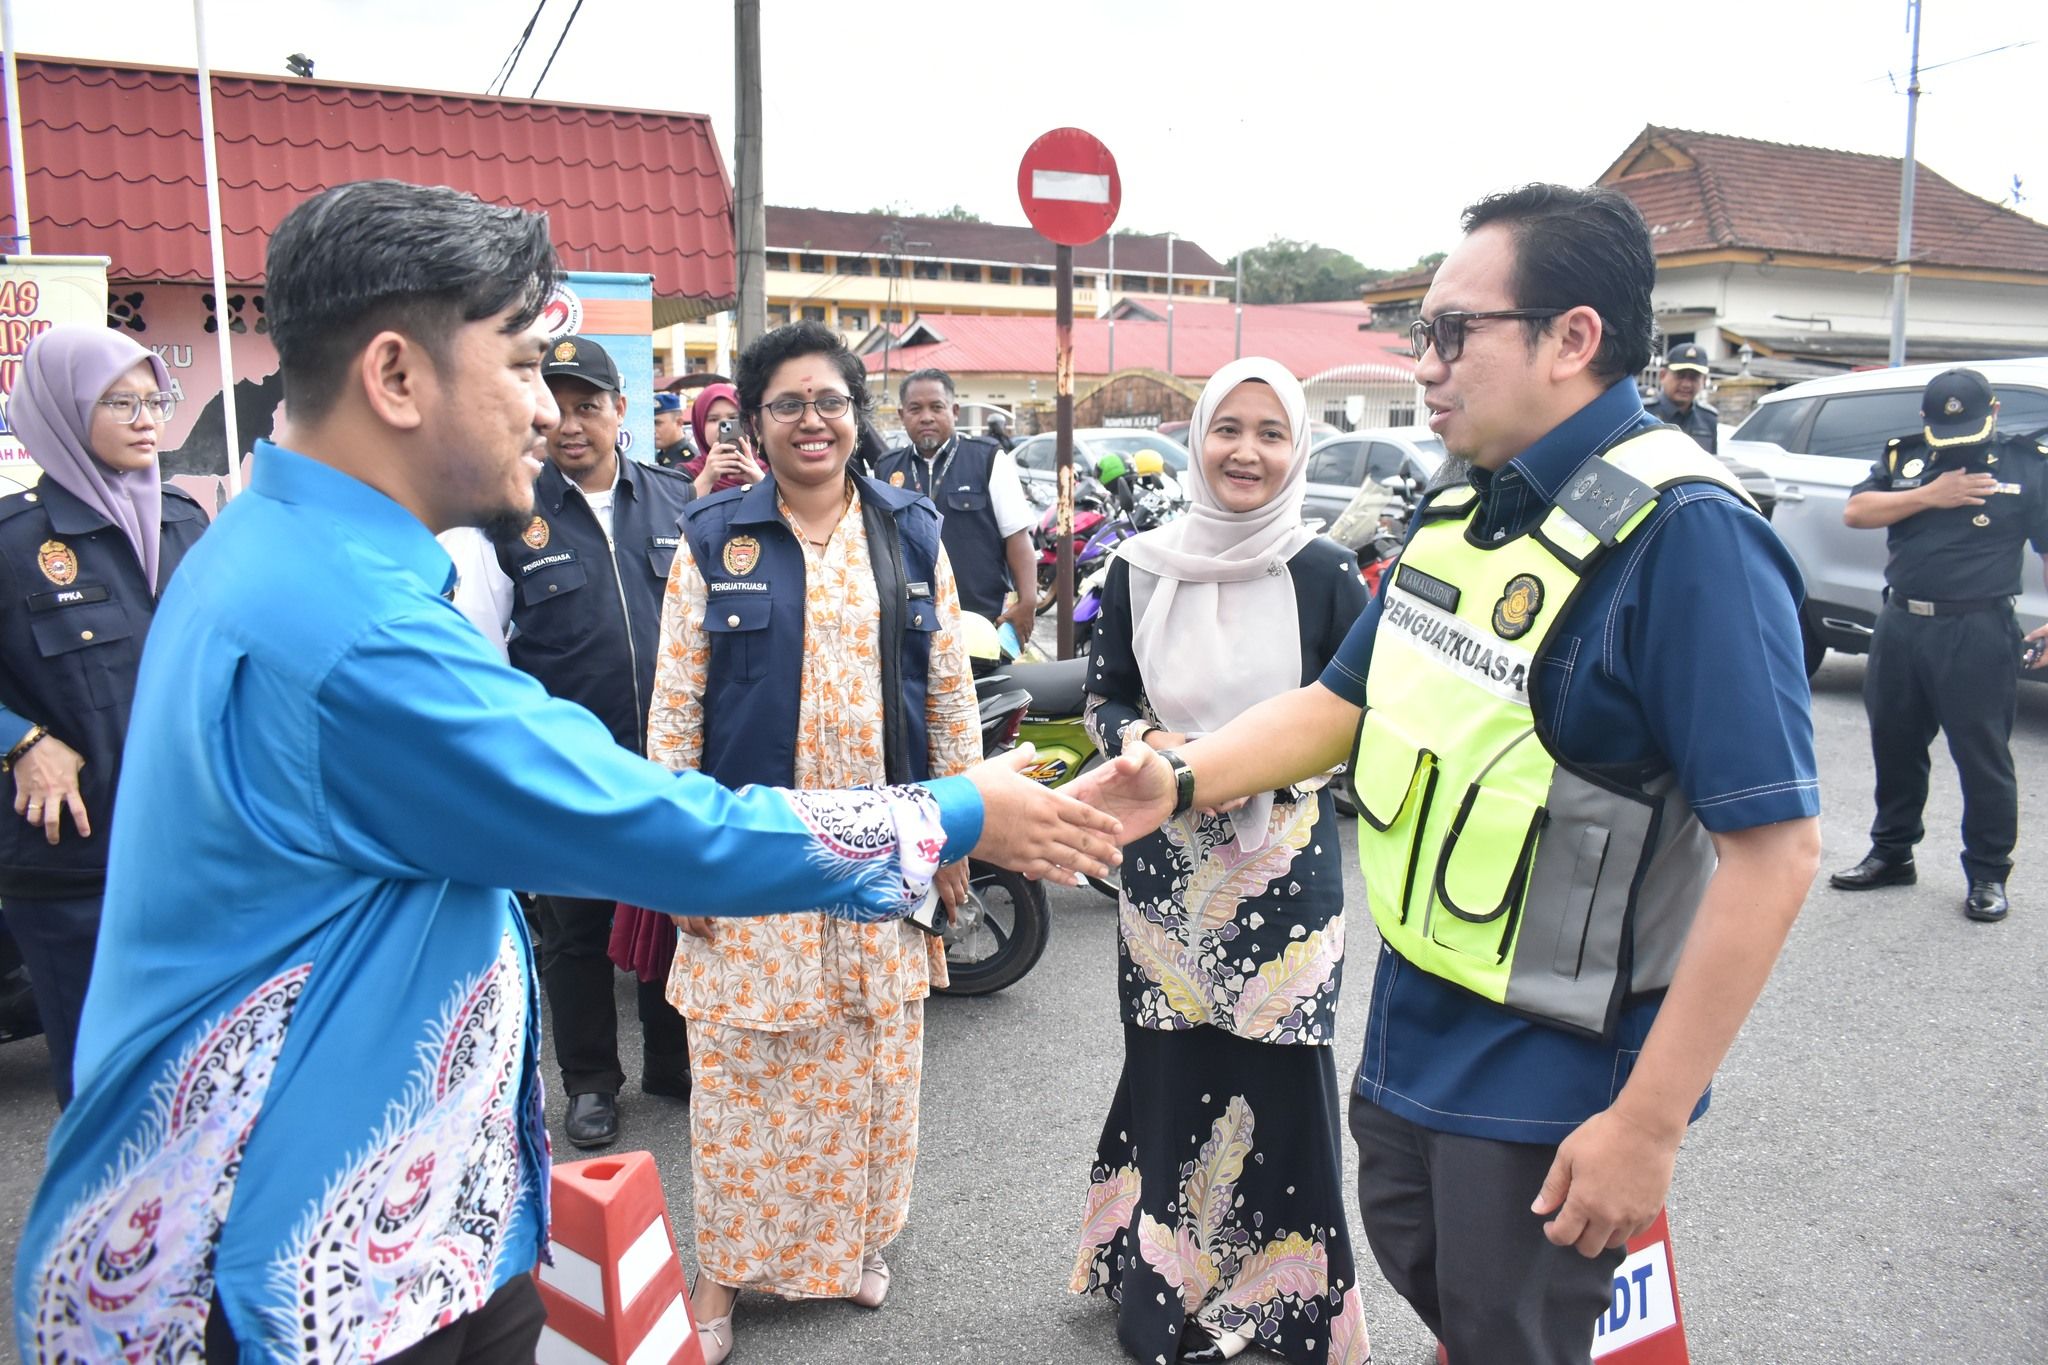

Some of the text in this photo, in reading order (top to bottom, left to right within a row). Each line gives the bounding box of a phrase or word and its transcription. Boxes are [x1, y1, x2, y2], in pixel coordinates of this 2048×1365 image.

[523, 553, 571, 573] PENGUATKUASA
[57, 591, 83, 602] PPKA
[711, 582, 767, 592] PENGUATKUASA
[1402, 571, 1452, 605] KAMALLUDIN
[1384, 595, 1526, 692] PENGUATKUASA
